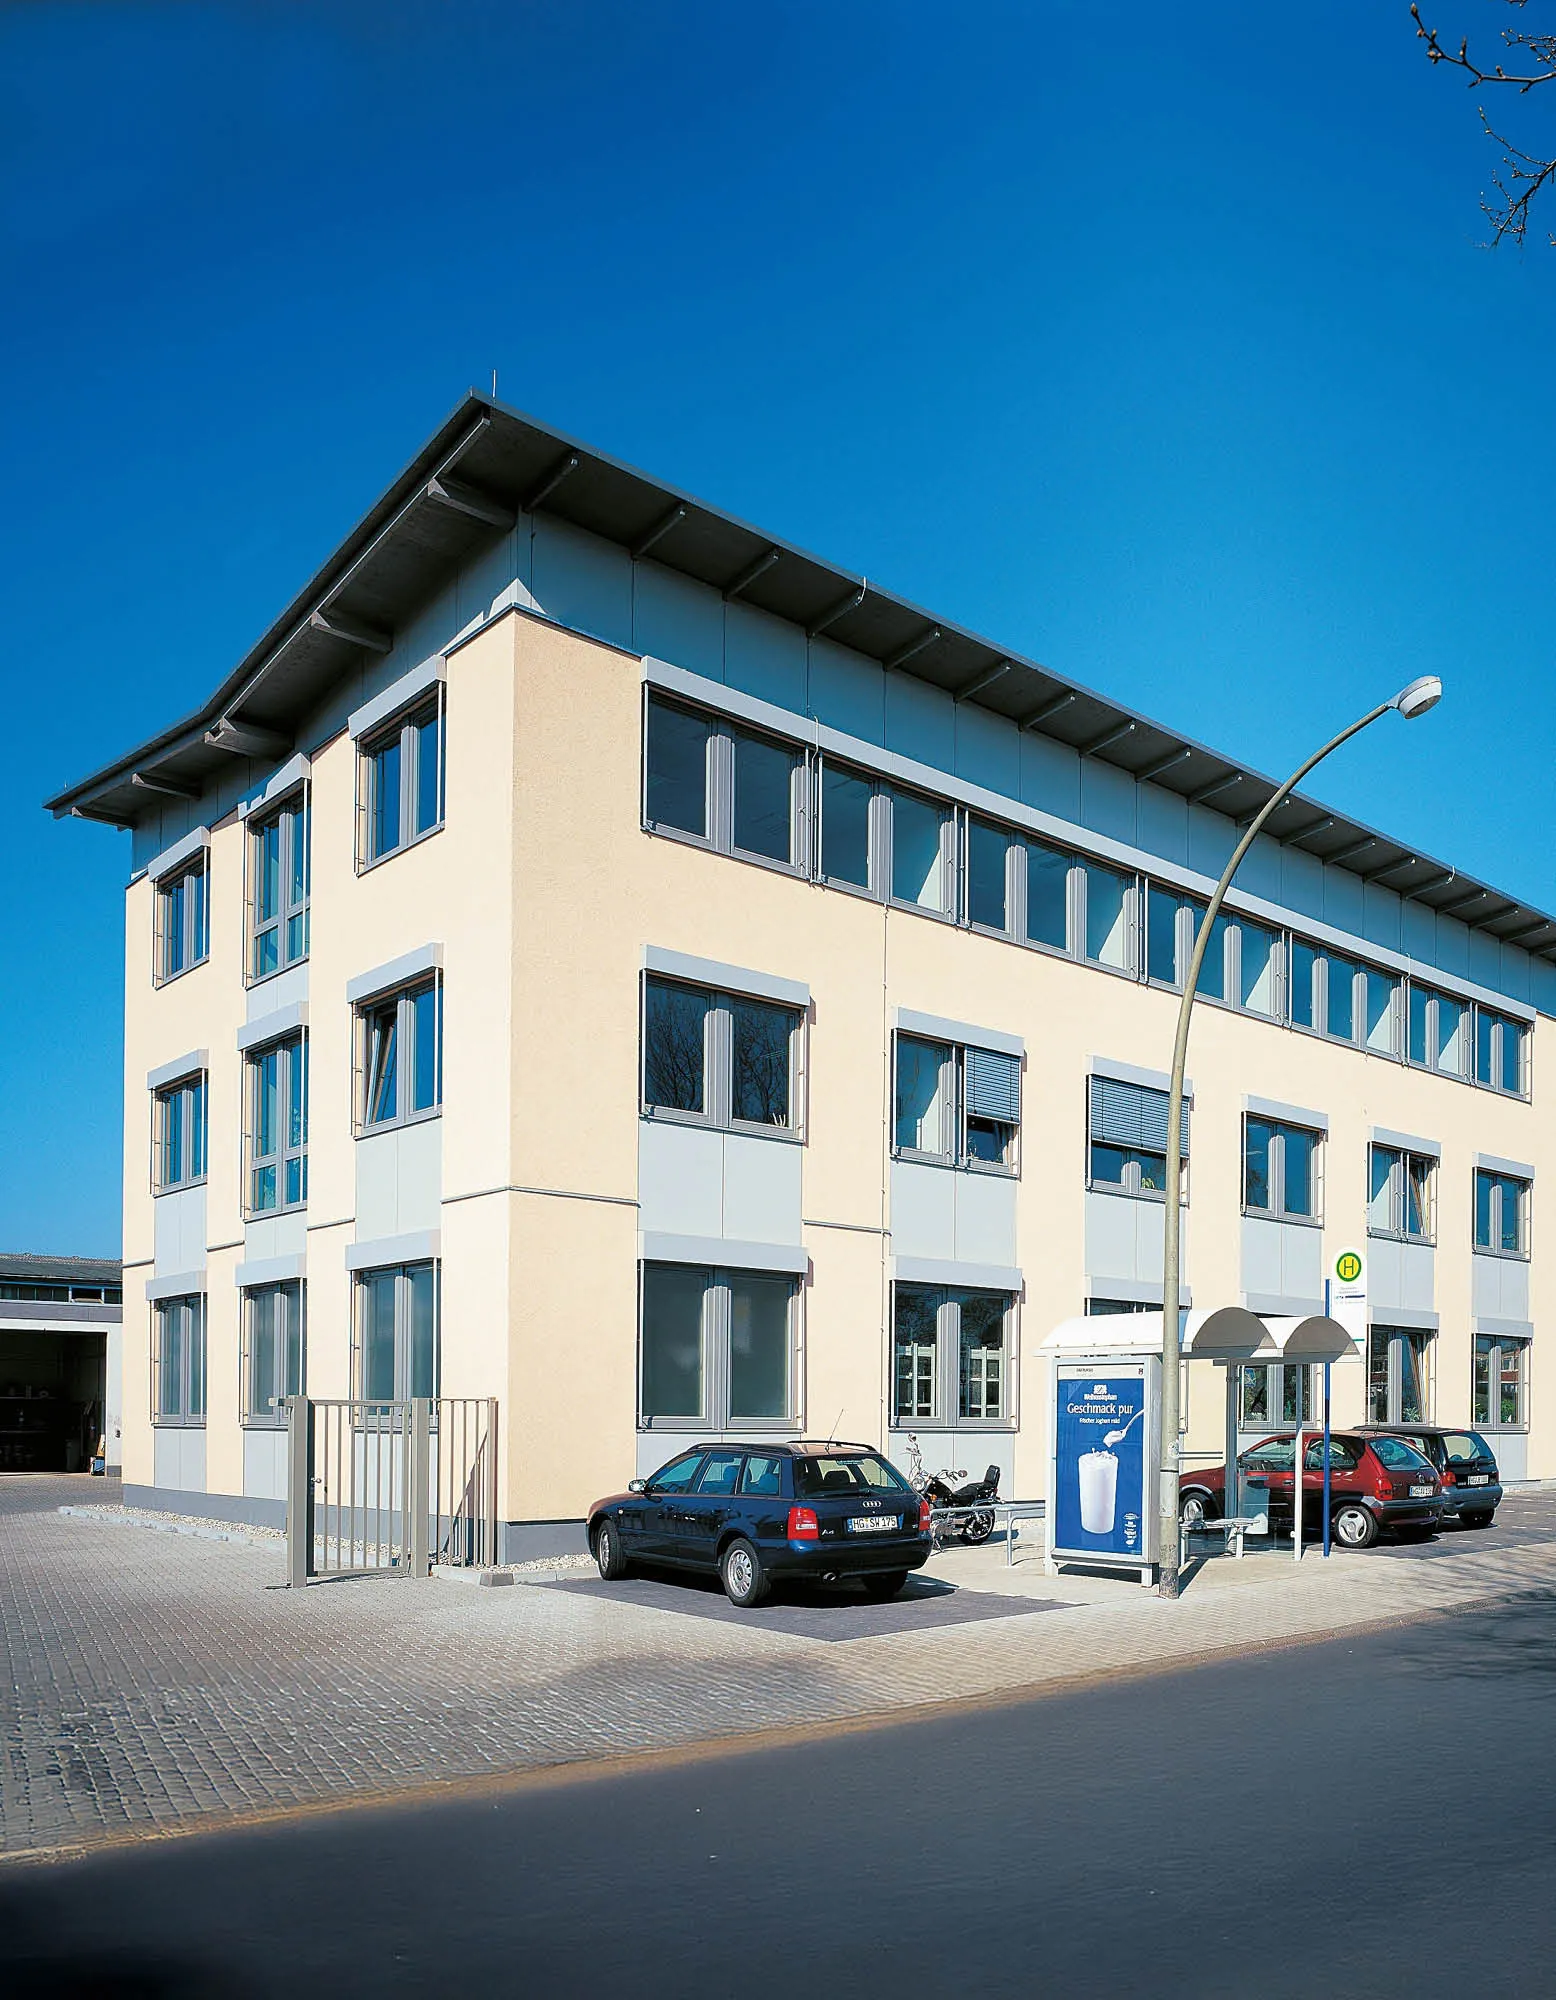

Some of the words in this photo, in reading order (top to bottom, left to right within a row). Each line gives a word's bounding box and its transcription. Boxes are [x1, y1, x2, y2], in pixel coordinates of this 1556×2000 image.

[1343, 1258, 1354, 1276] H
[1066, 1403, 1116, 1414] Geschmack
[1118, 1405, 1134, 1417] pur
[853, 1518, 865, 1529] HG
[882, 1515, 896, 1527] 175
